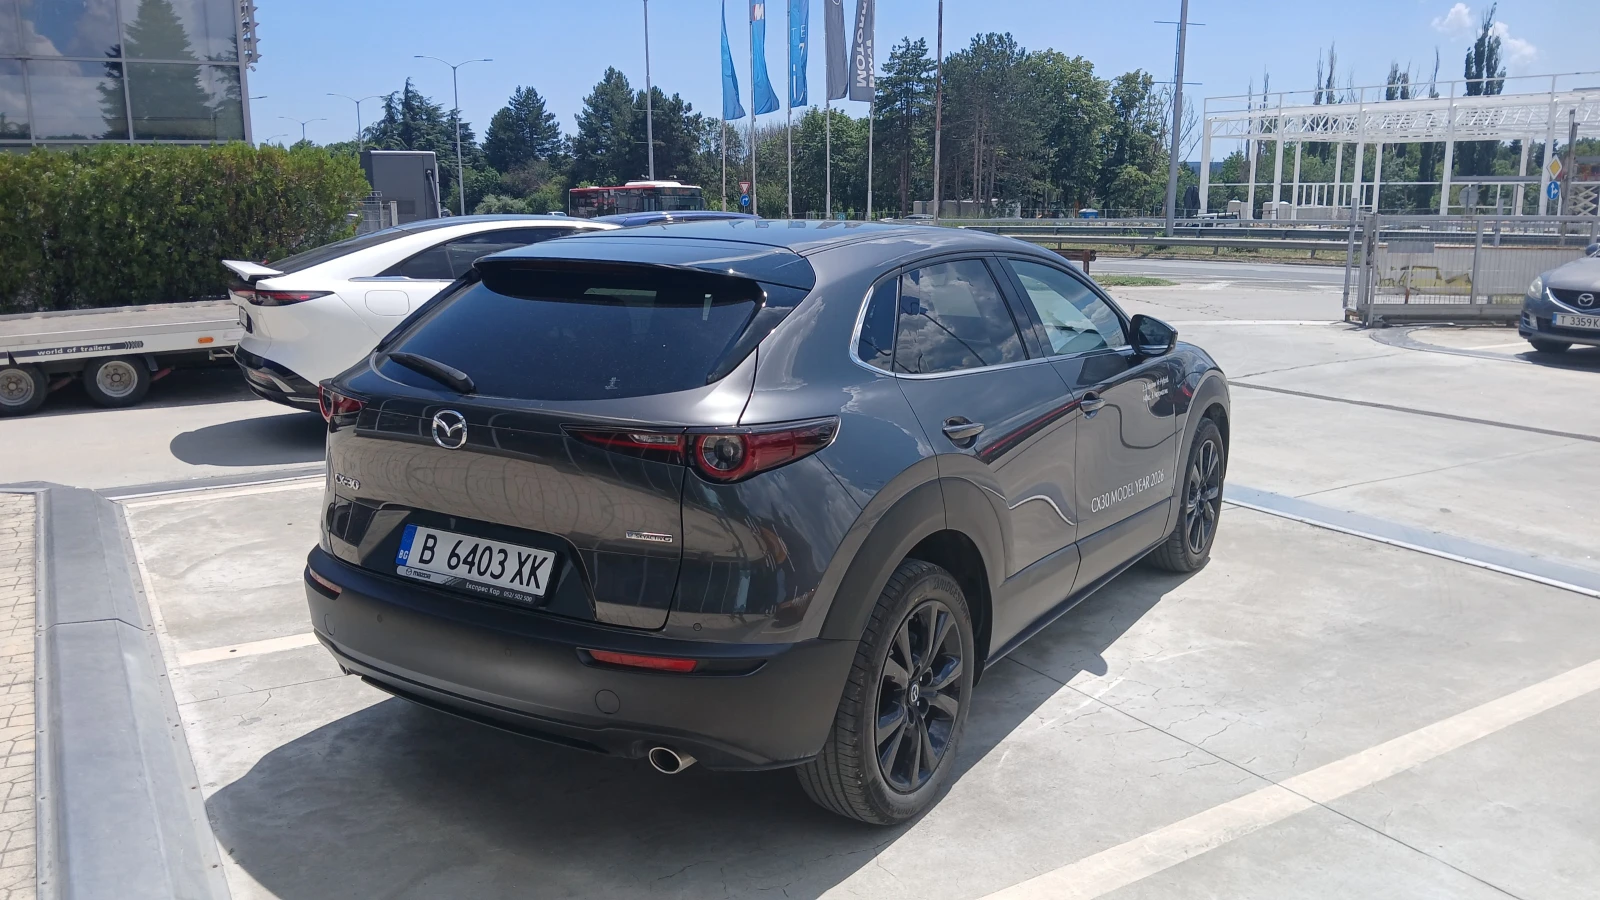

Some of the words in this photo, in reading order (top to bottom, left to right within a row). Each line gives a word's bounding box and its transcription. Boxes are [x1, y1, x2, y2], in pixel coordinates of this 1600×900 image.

[1560, 315, 1566, 325] T
[1570, 316, 1592, 327] 3359
[37, 348, 63, 356] world
[335, 473, 360, 490] CX-30
[1091, 491, 1110, 513] CX30
[1110, 481, 1135, 506] MODEL
[1134, 474, 1150, 494] YEAR
[1150, 468, 1165, 487] 2026
[398, 549, 409, 560] BG
[418, 533, 438, 565] B
[447, 539, 508, 580] 6403
[509, 551, 548, 590] XK
[465, 582, 488, 592] Експрес
[490, 587, 500, 597] Кар
